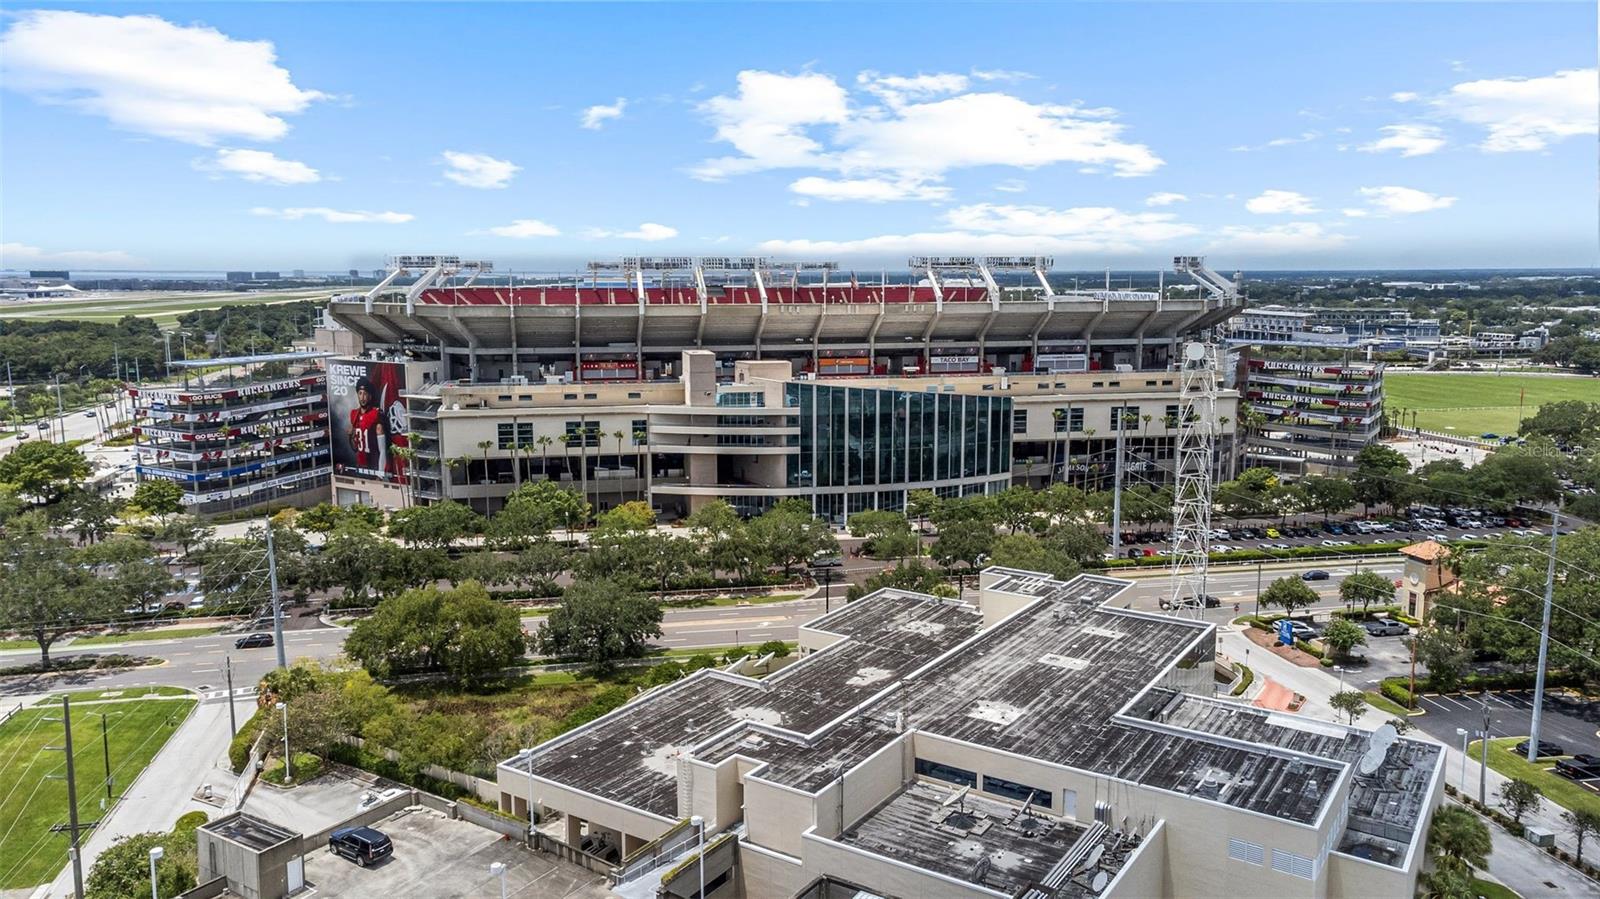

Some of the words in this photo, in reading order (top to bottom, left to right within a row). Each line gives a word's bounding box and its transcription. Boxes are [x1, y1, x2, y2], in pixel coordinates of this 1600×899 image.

[329, 363, 367, 377] KREWE
[204, 392, 223, 400] BUCS
[355, 428, 370, 453] 31
